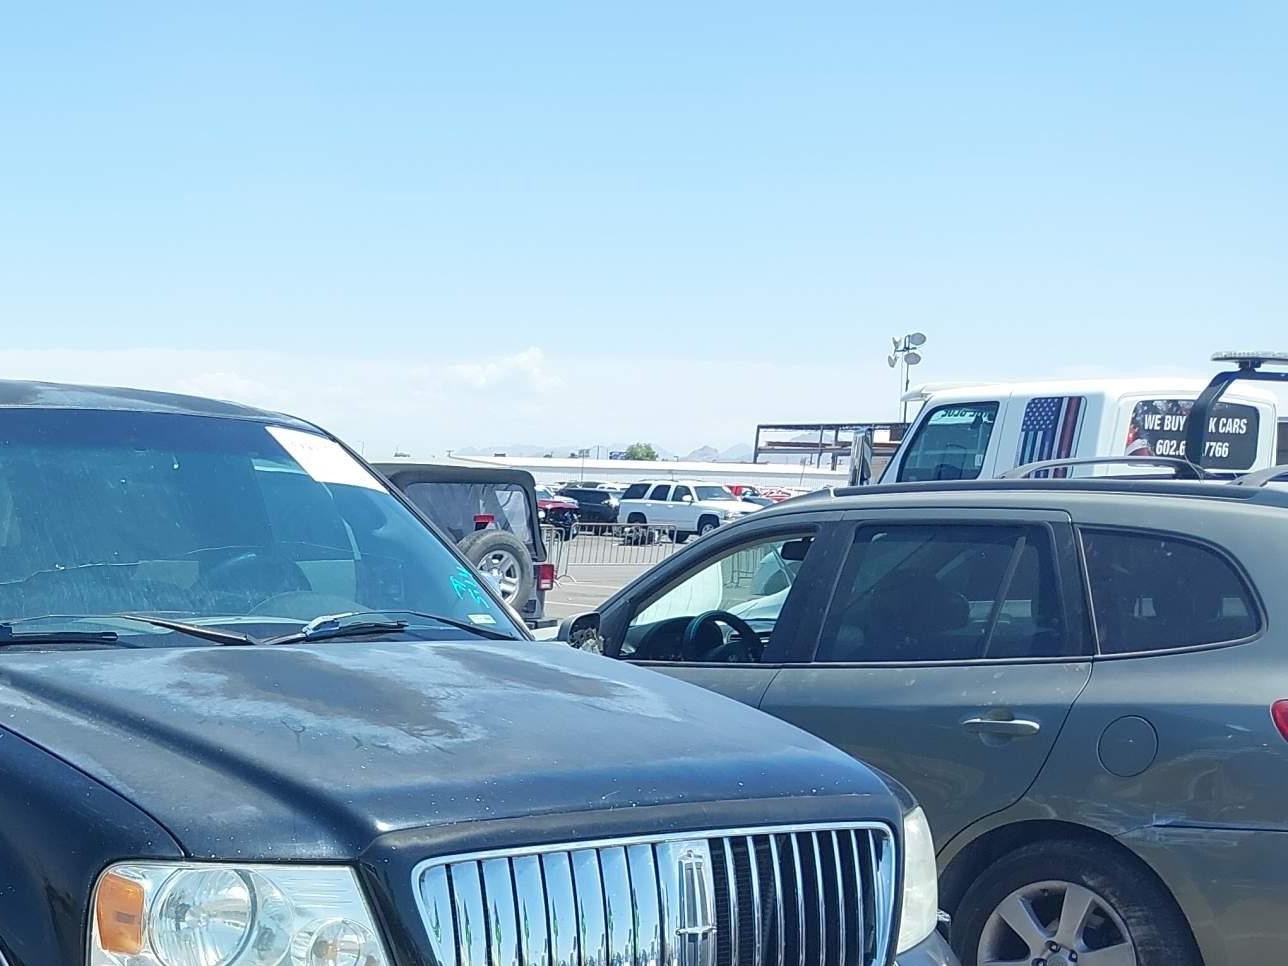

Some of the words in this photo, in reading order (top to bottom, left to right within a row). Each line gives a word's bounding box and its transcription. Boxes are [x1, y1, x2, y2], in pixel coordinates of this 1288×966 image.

[1144, 414, 1161, 431] WE
[1163, 415, 1187, 432] BUY
[1218, 417, 1248, 435] CARS
